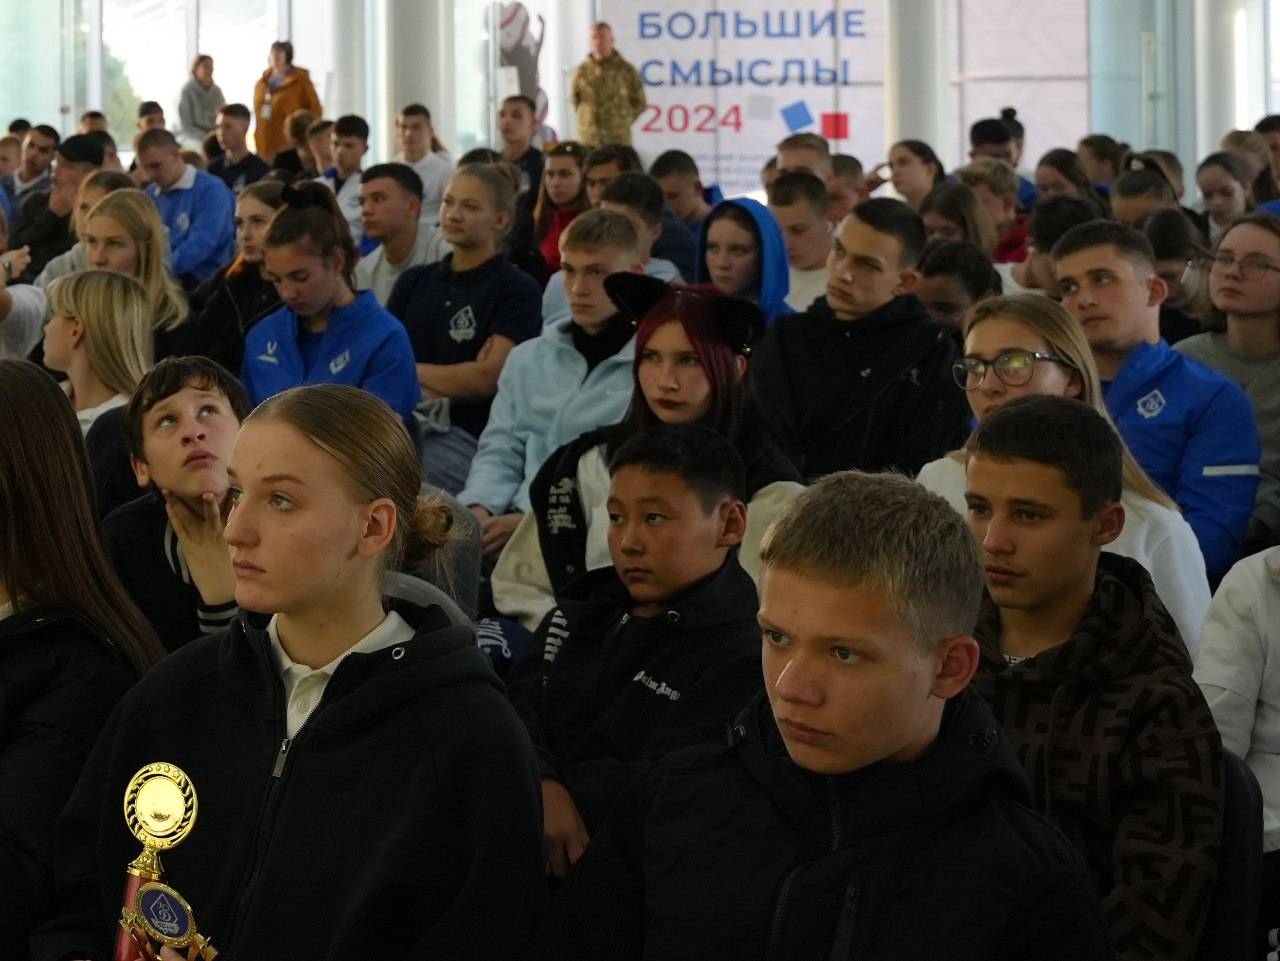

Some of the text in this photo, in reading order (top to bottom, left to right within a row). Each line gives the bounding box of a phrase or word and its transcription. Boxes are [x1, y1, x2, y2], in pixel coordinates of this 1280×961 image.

[637, 9, 867, 40] БОЛЬШИЕ
[641, 58, 851, 88] СМЫСЛЫ
[640, 103, 744, 134] 2024
